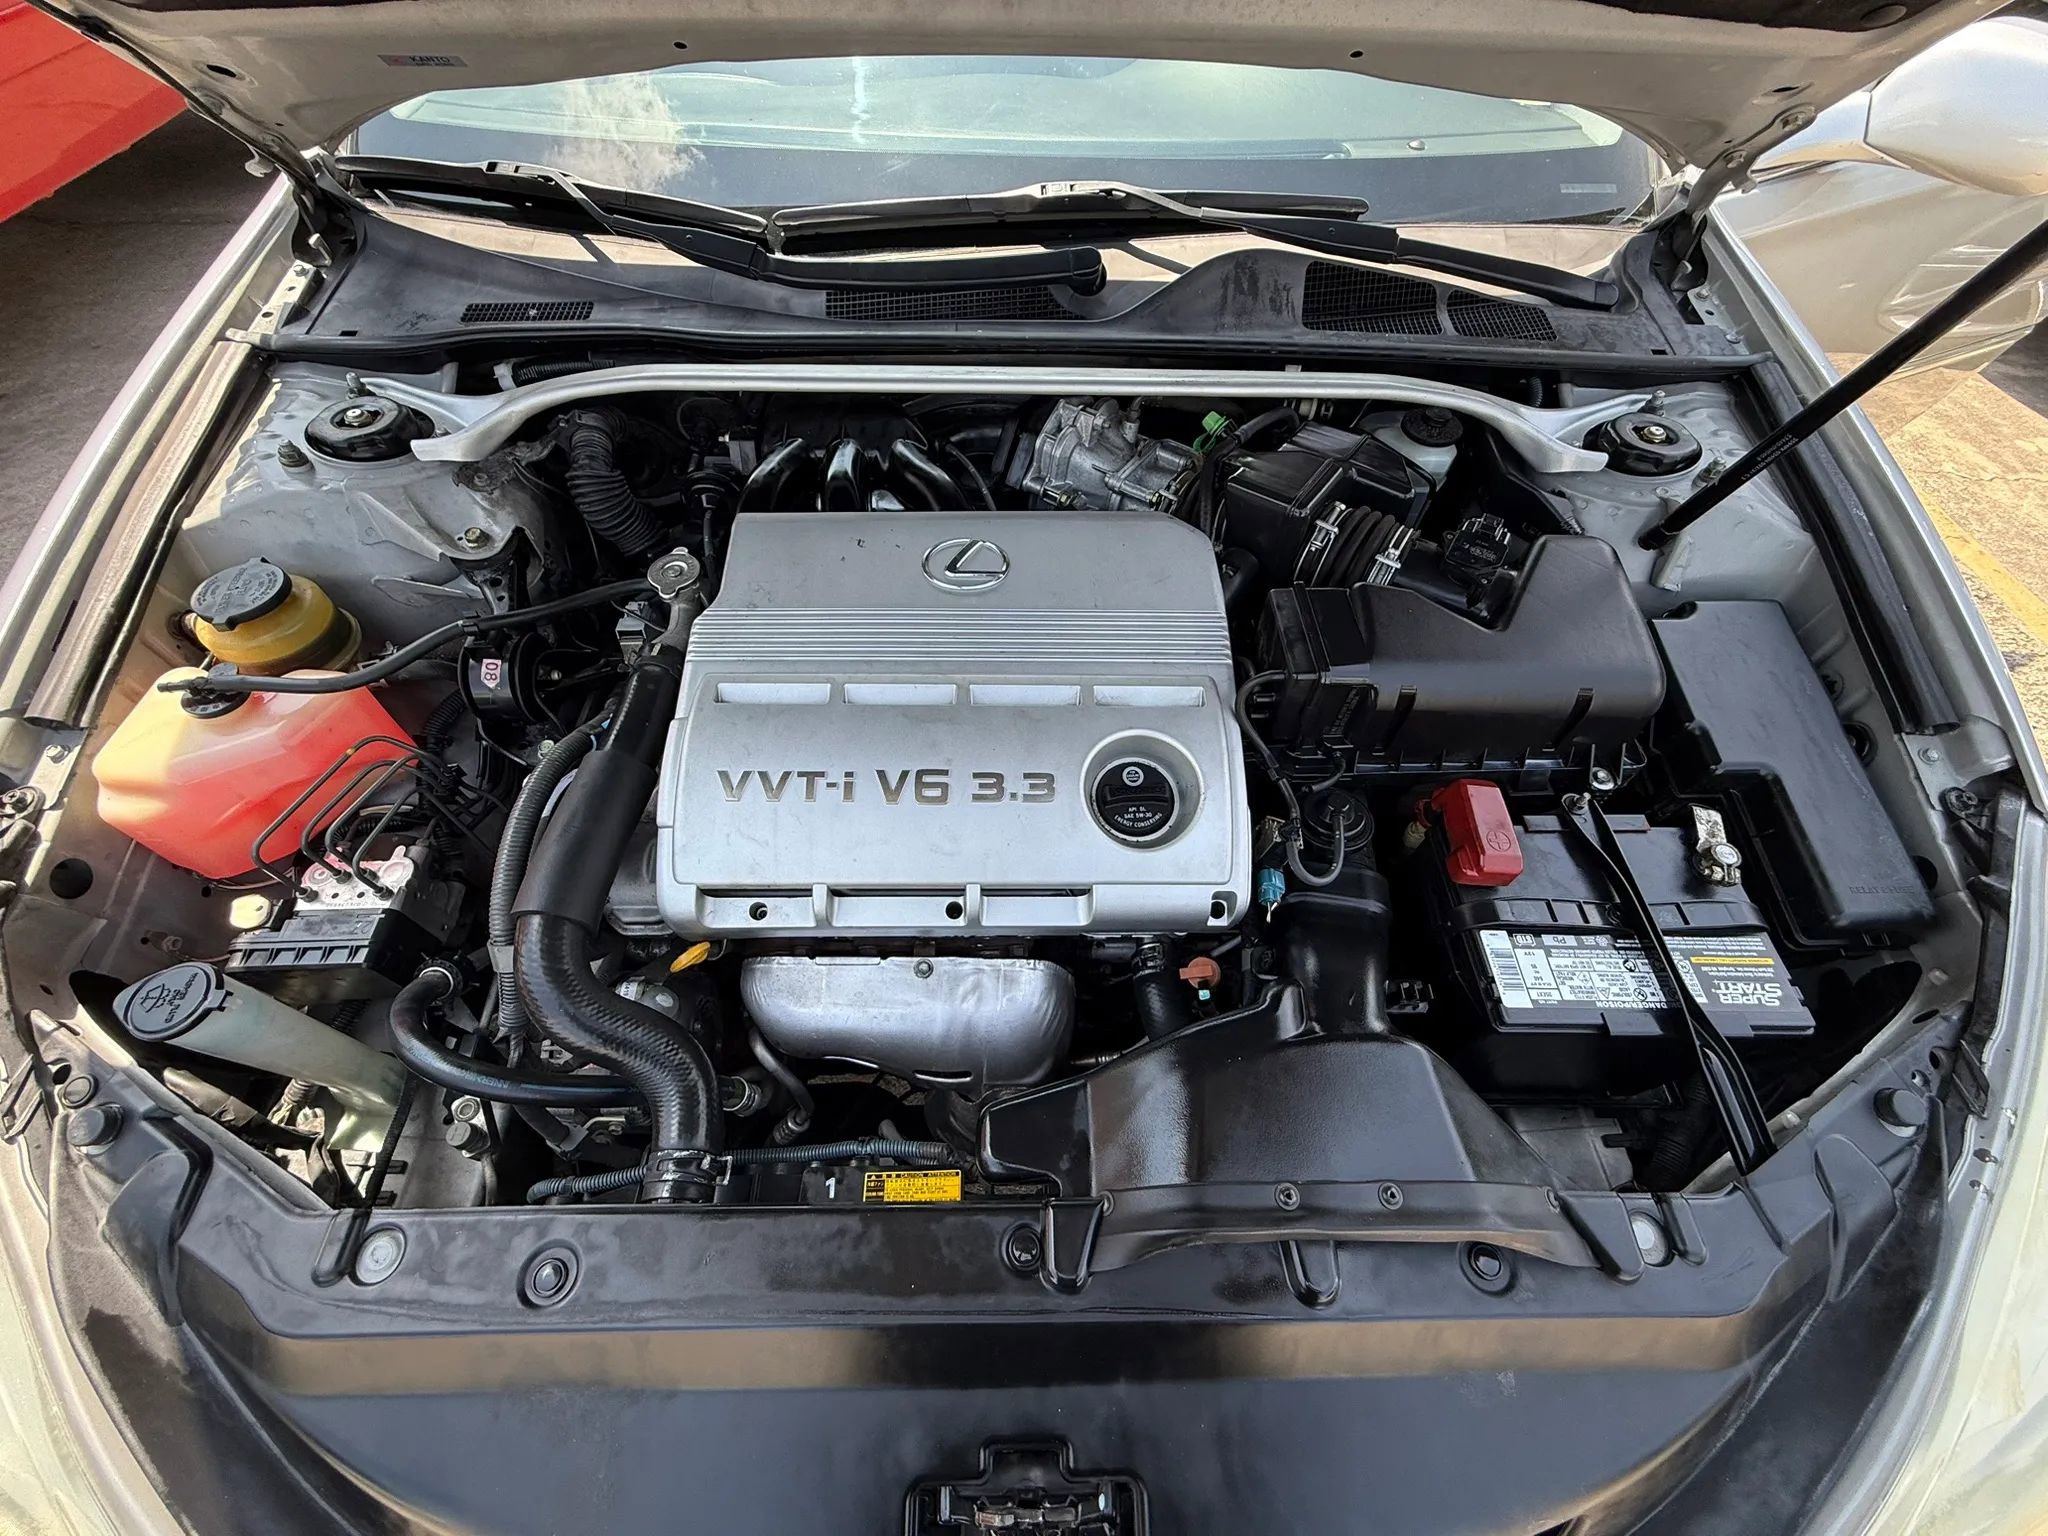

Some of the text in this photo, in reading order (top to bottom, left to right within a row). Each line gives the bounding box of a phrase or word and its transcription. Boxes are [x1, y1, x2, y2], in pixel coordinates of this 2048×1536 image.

[716, 767, 1057, 805] VVT-i V6 3.3
[1552, 936, 1567, 944] Pb
[1719, 982, 1782, 997] START
[1721, 992, 1781, 1006] SUPER
[825, 1177, 836, 1199] 1
